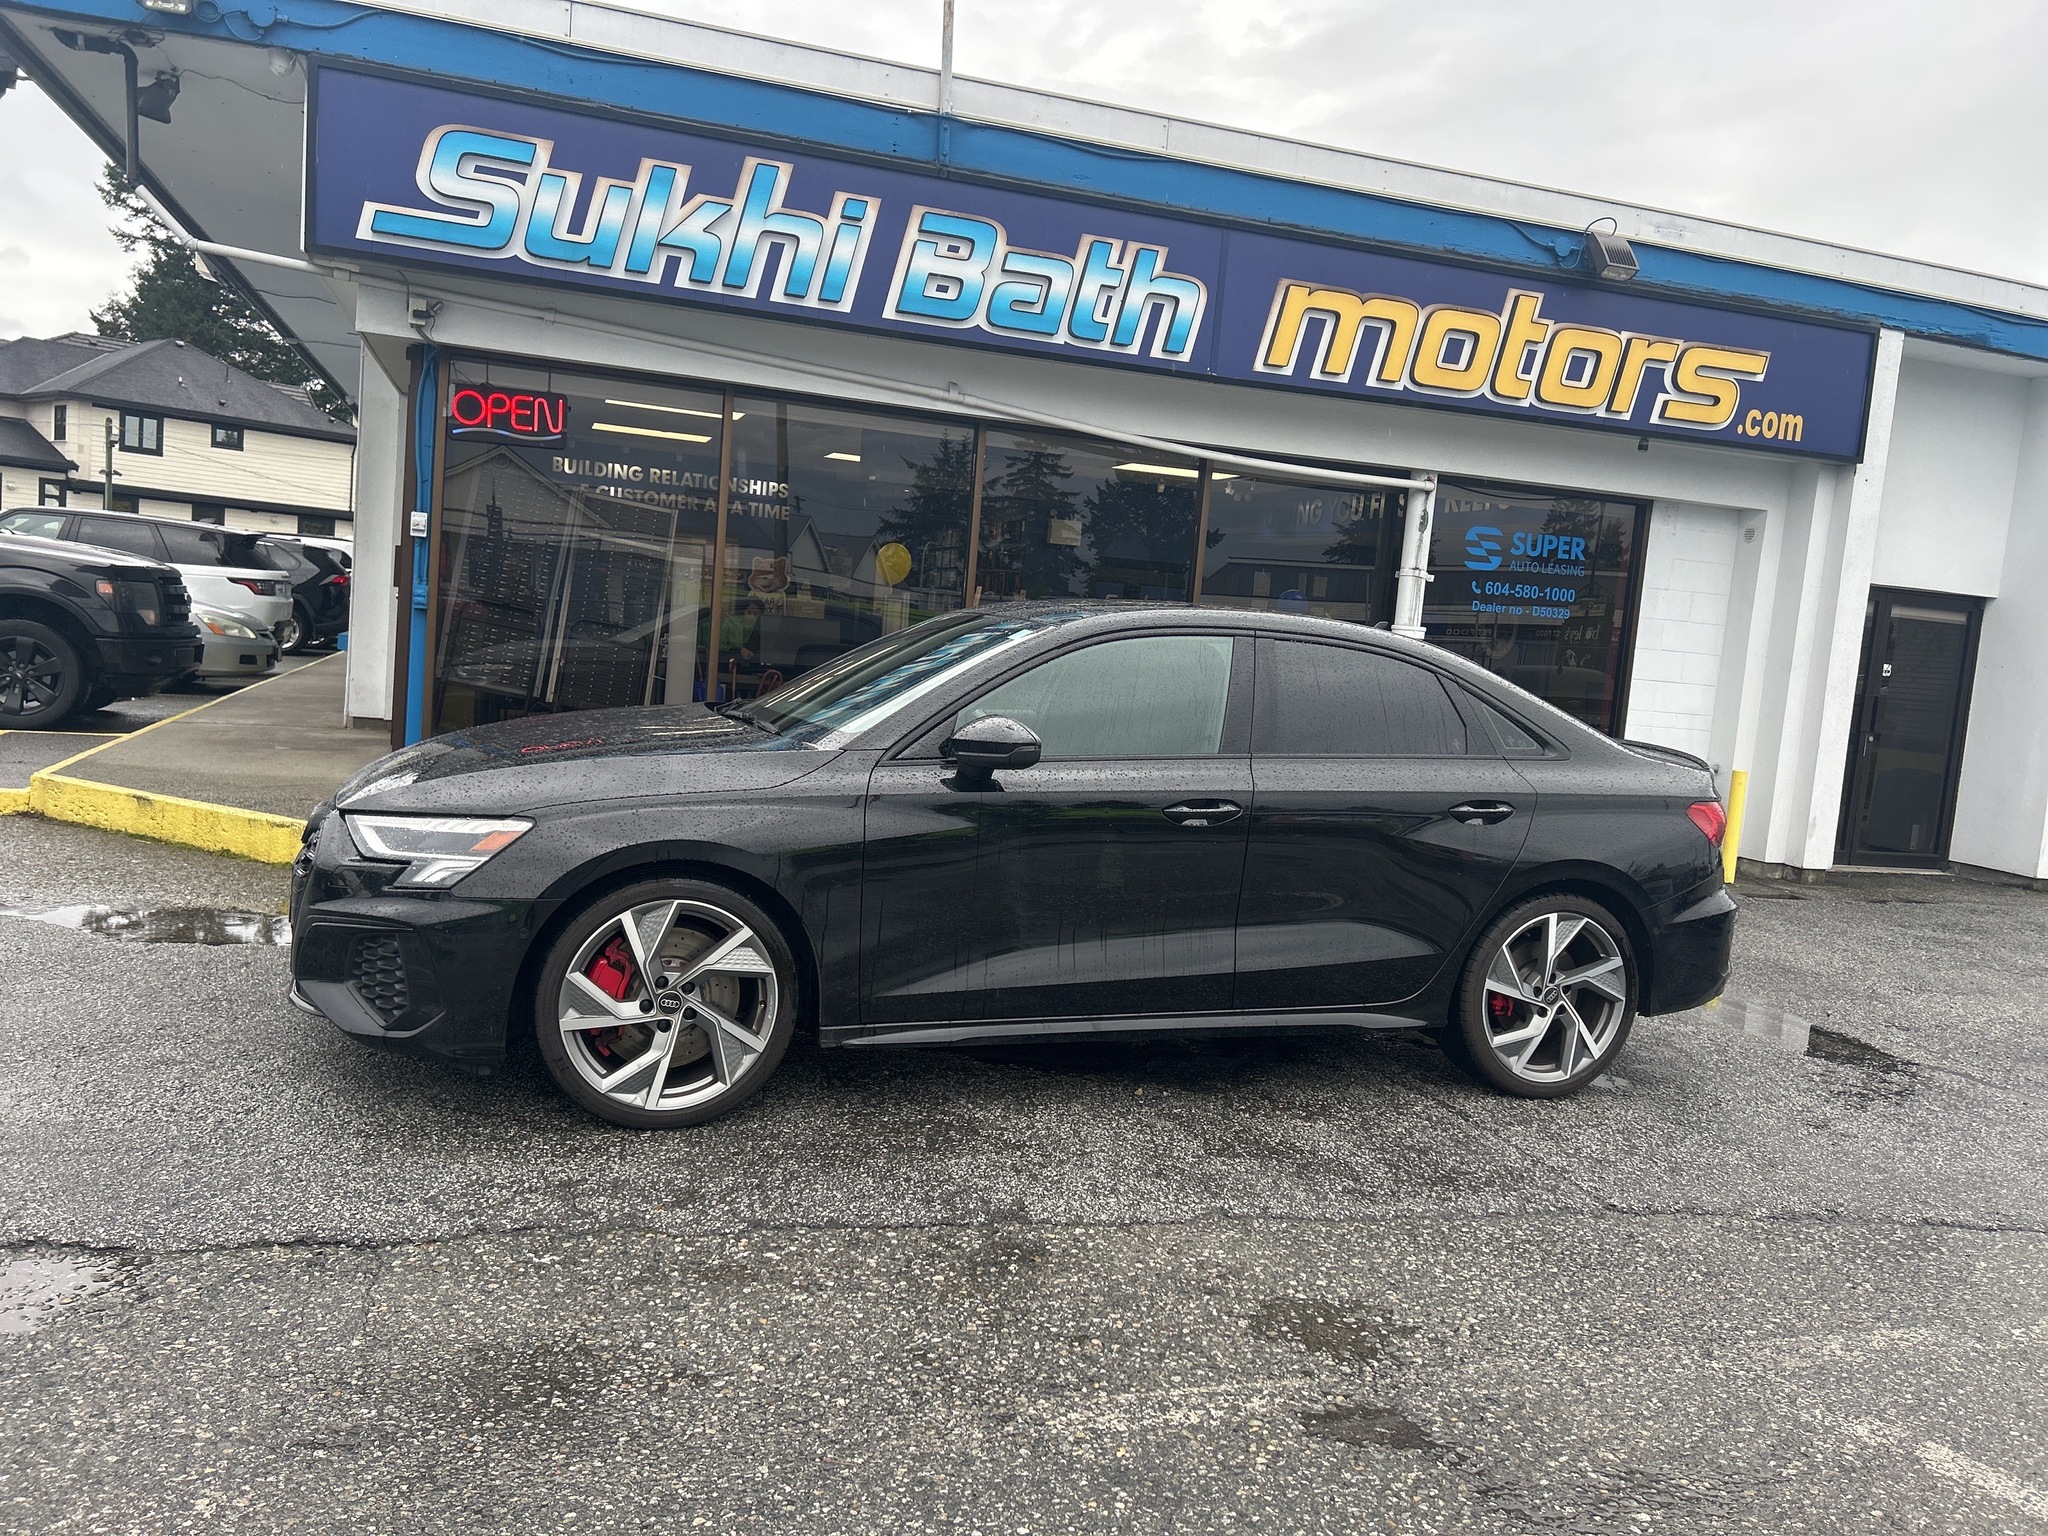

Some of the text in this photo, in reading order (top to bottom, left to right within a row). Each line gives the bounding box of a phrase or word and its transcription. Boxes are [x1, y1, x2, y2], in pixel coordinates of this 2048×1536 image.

[356, 124, 1804, 442] Sukhi Bath motors .com
[452, 389, 564, 434] OPEN
[552, 456, 790, 498] BUILDING RELATIONSHIPS
[703, 499, 718, 513] A
[748, 502, 790, 521] TIME
[1510, 531, 1586, 560] SUPER
[1509, 560, 1585, 577] AUTO LEASING
[1485, 581, 1576, 603] 604-580-1000
[1472, 600, 1506, 614] Dealer
[1509, 605, 1522, 615] no
[1532, 606, 1570, 619] D50329
